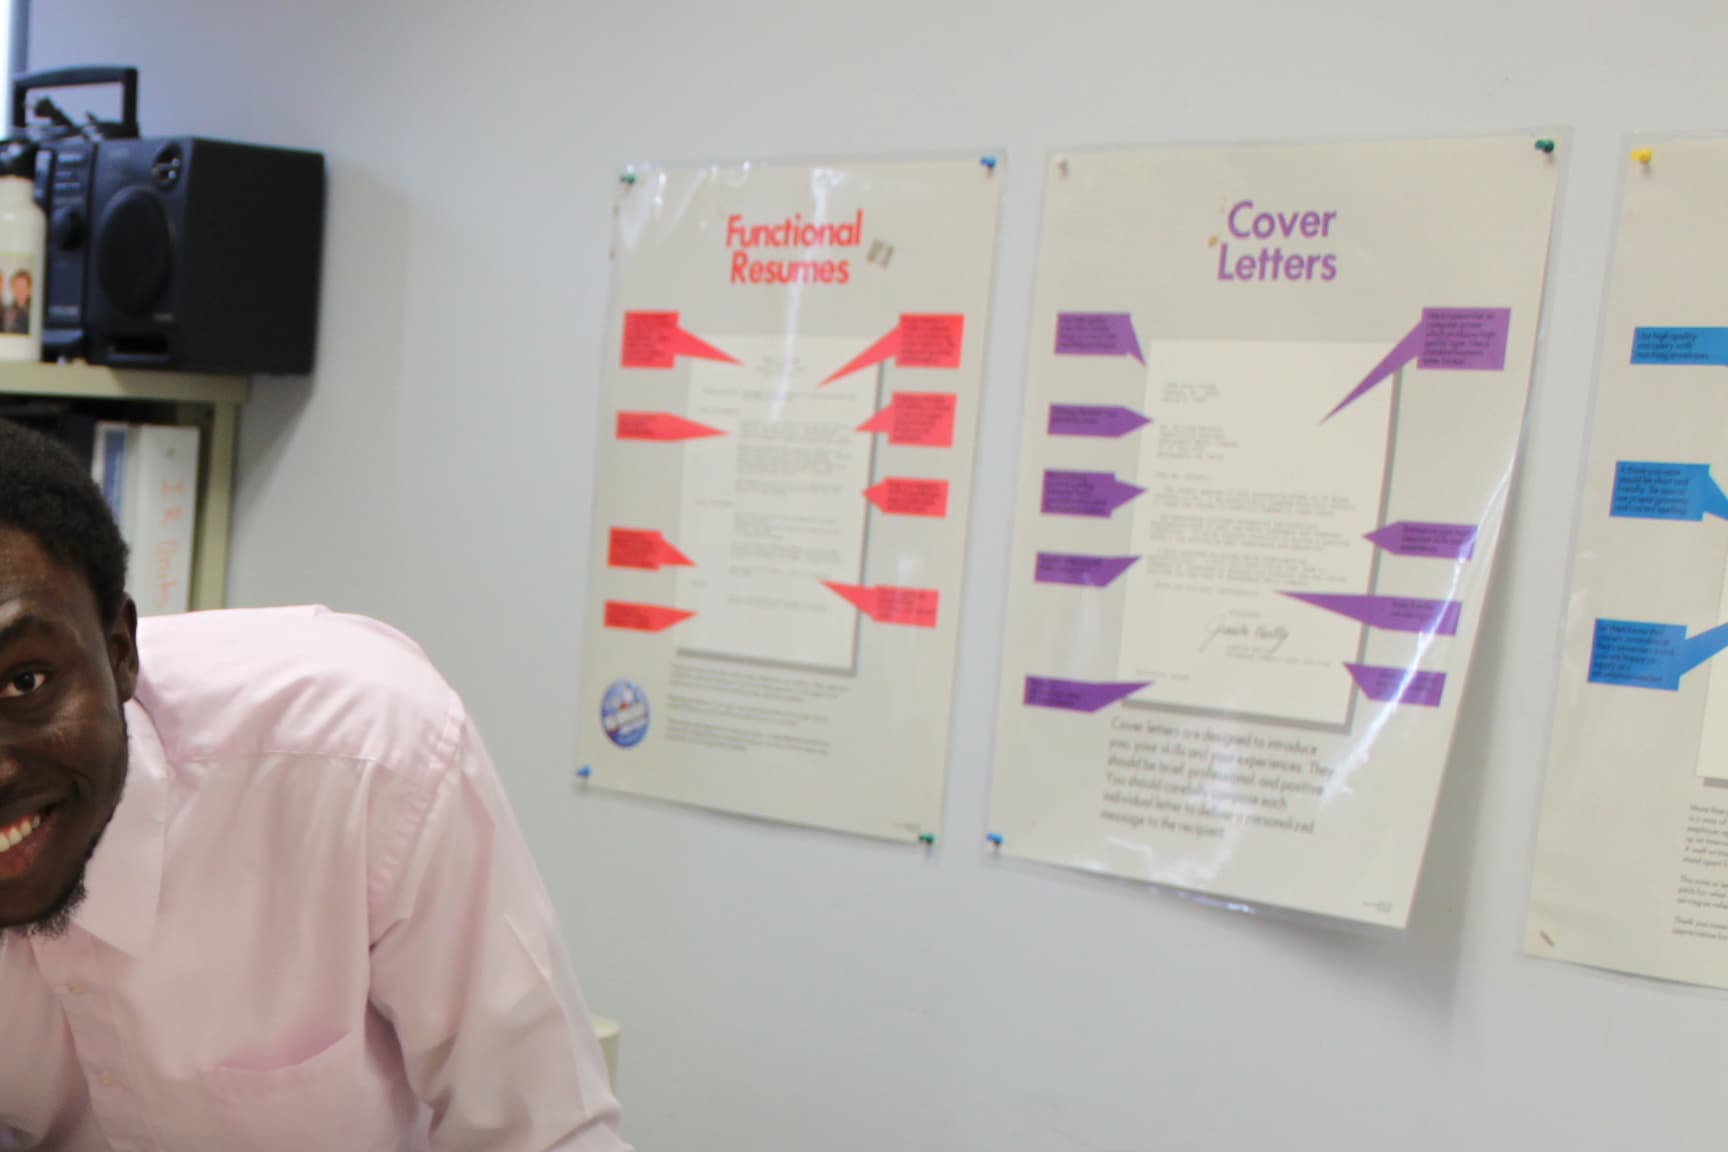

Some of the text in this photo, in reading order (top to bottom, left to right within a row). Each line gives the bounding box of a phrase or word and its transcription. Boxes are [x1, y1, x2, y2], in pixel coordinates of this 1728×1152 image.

[725, 208, 864, 249] Functional
[1227, 200, 1338, 240] Cover
[730, 251, 851, 285] Resumes
[1217, 243, 1338, 282] Letters
